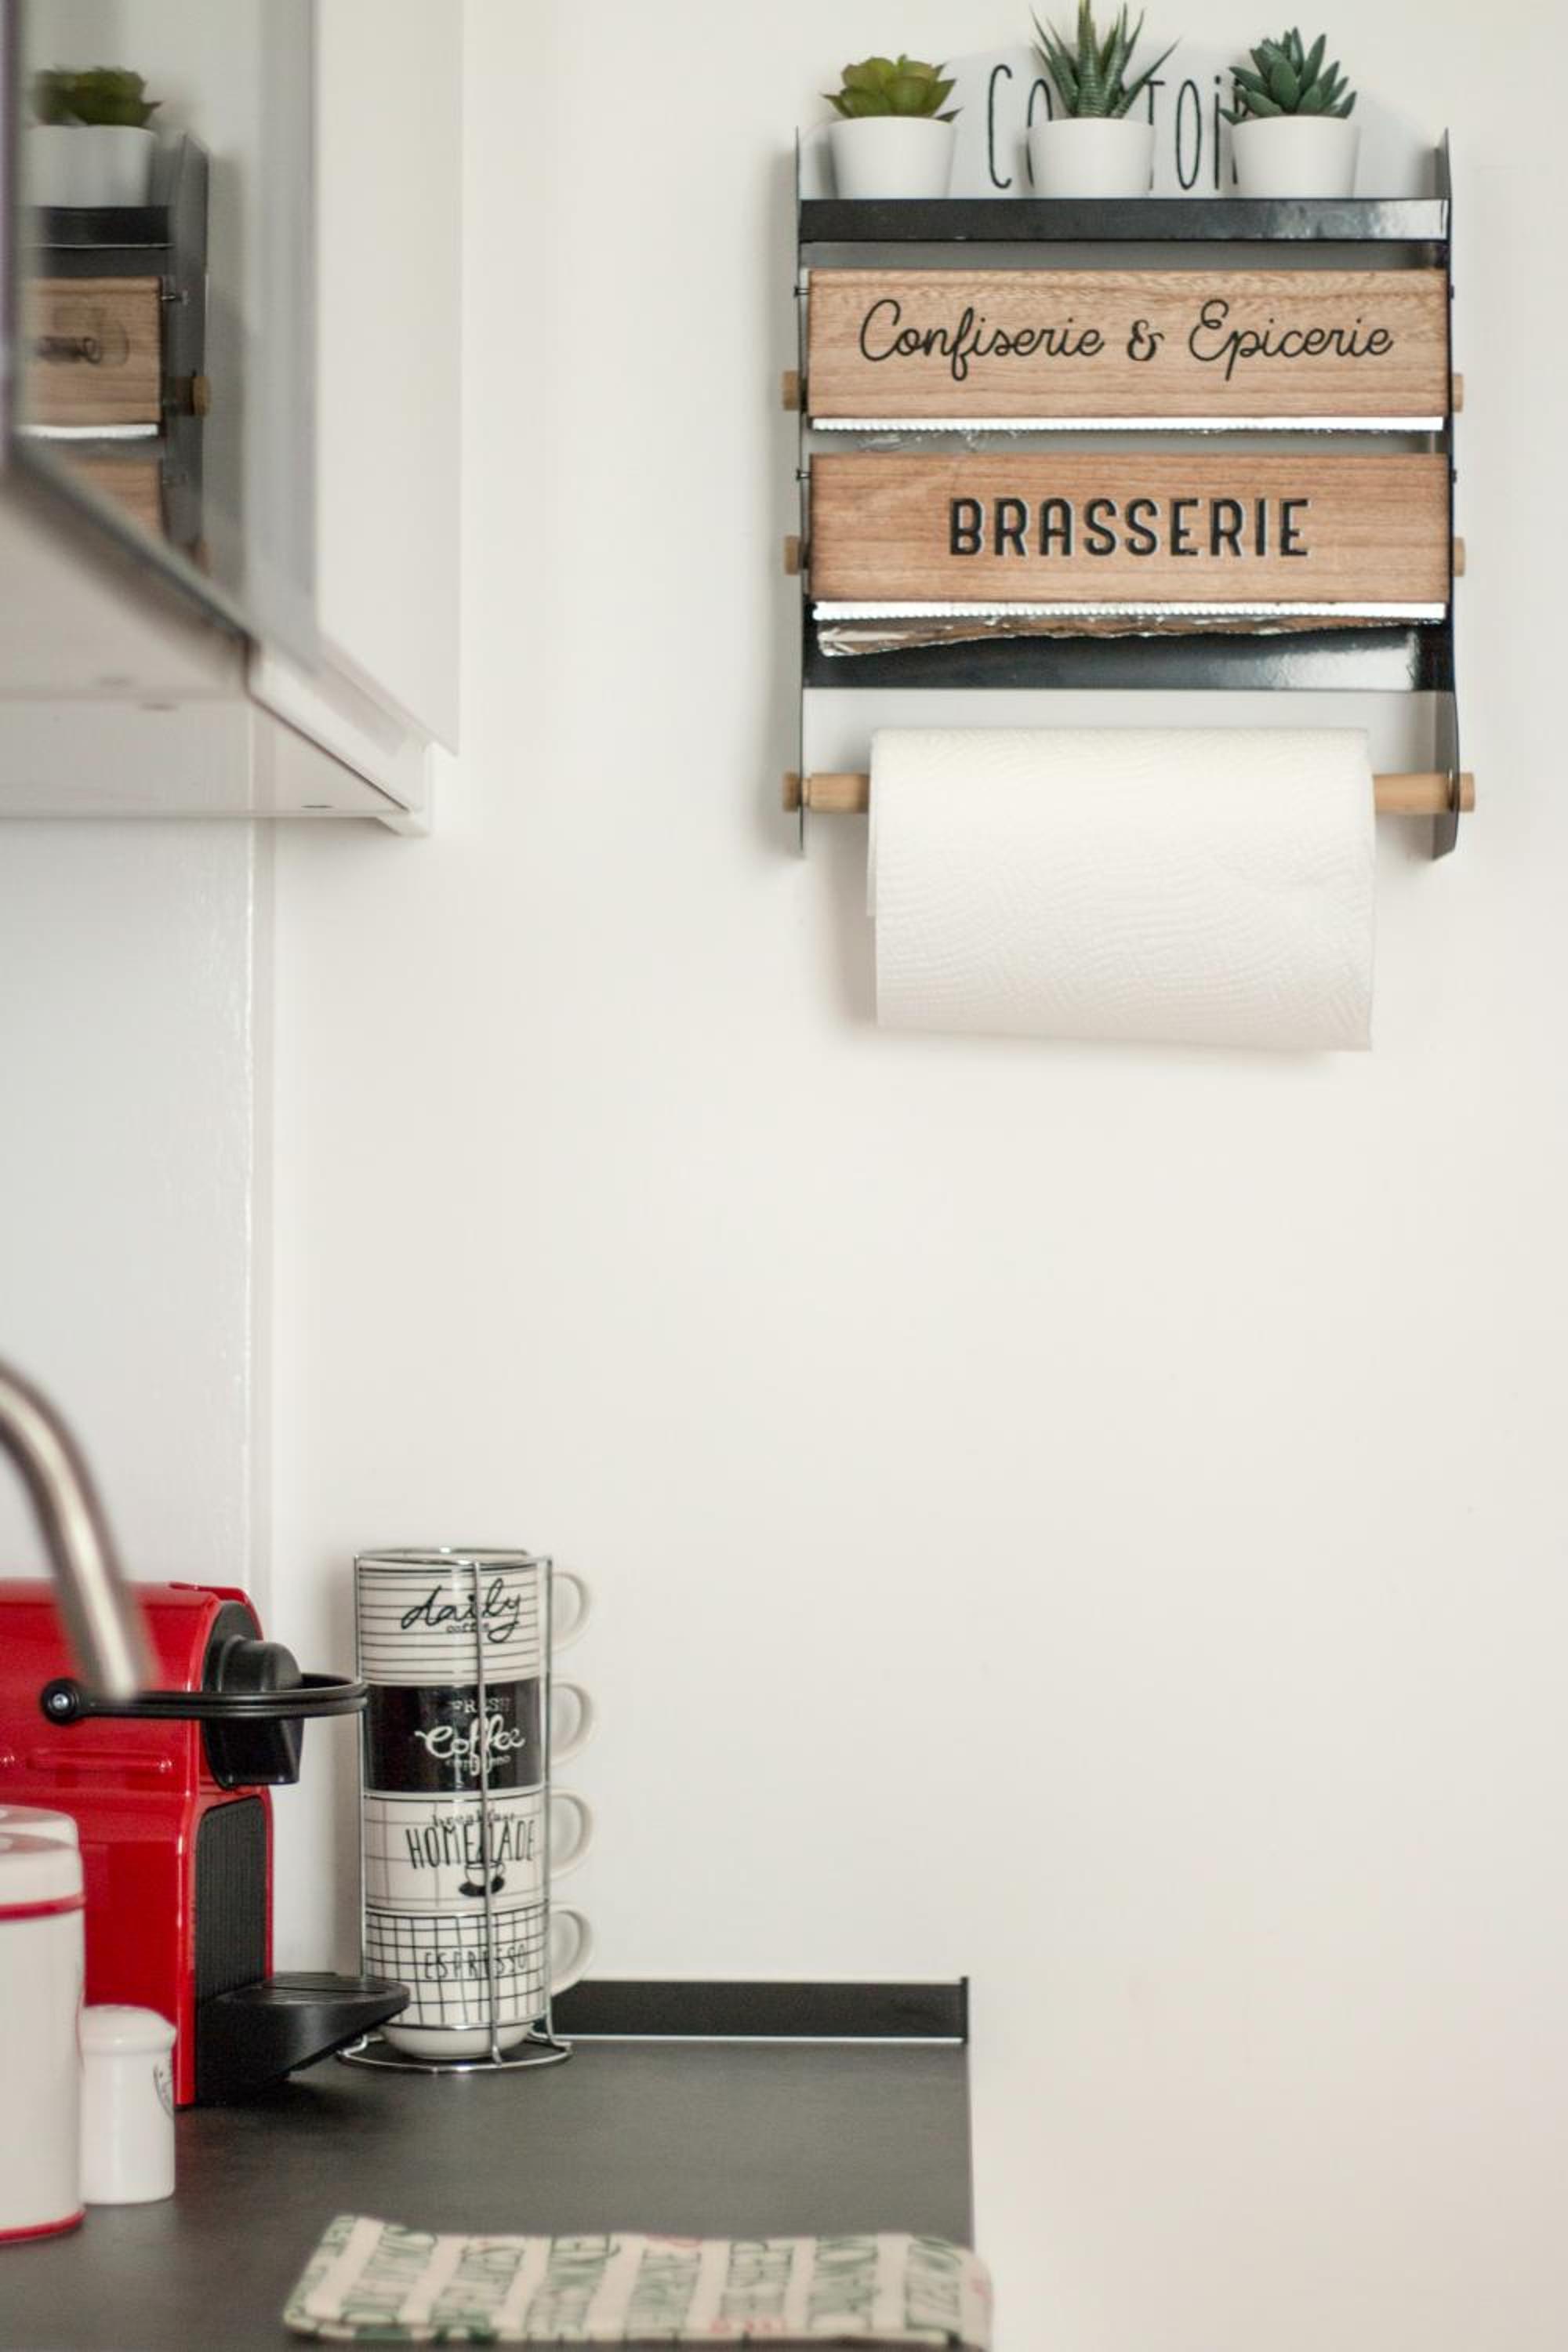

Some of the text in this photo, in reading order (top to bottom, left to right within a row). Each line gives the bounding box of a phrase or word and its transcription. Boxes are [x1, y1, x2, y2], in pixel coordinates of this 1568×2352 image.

[989, 64, 1250, 190] COTOi
[859, 298, 1395, 383] Confiserie & Epicerie
[949, 498, 1310, 557] BRASSERIE
[401, 1577, 521, 1643] daily
[451, 1697, 511, 1714] FRSH
[414, 1714, 526, 1777] Coffee
